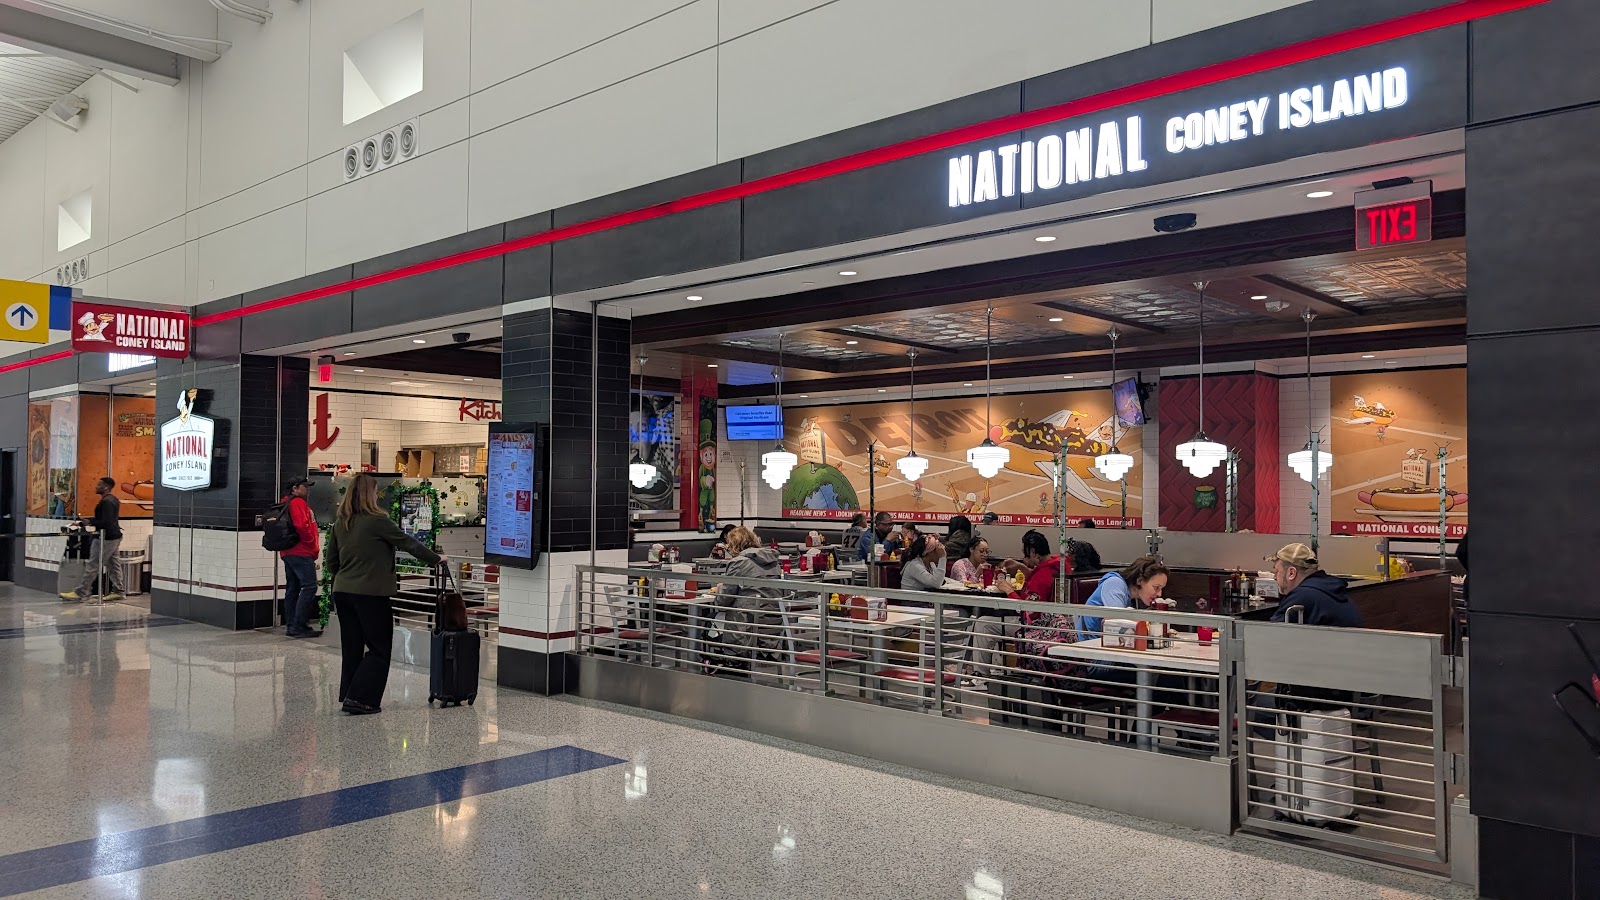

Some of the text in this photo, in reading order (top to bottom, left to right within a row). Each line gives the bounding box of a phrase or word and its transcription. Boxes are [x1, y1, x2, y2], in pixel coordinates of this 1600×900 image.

[947, 67, 1408, 207] NATIONAL CONEY ISLAND
[116, 312, 186, 340] NATIONAL
[115, 335, 185, 352] CONEY ISLAND
[308, 393, 340, 454] t
[817, 408, 986, 457] DETROIT
[165, 435, 208, 460] NATIONAL
[165, 459, 207, 472] CONEY ISLAND
[789, 509, 812, 517] HEADLINE
[898, 512, 914, 520] MEAL?
[1025, 515, 1040, 524] Your
[1042, 516, 1061, 526] Cony
[1092, 517, 1105, 526] has
[1106, 518, 1136, 526] Land!
[1356, 523, 1410, 534] NATIONAL
[843, 535, 860, 549] 47
